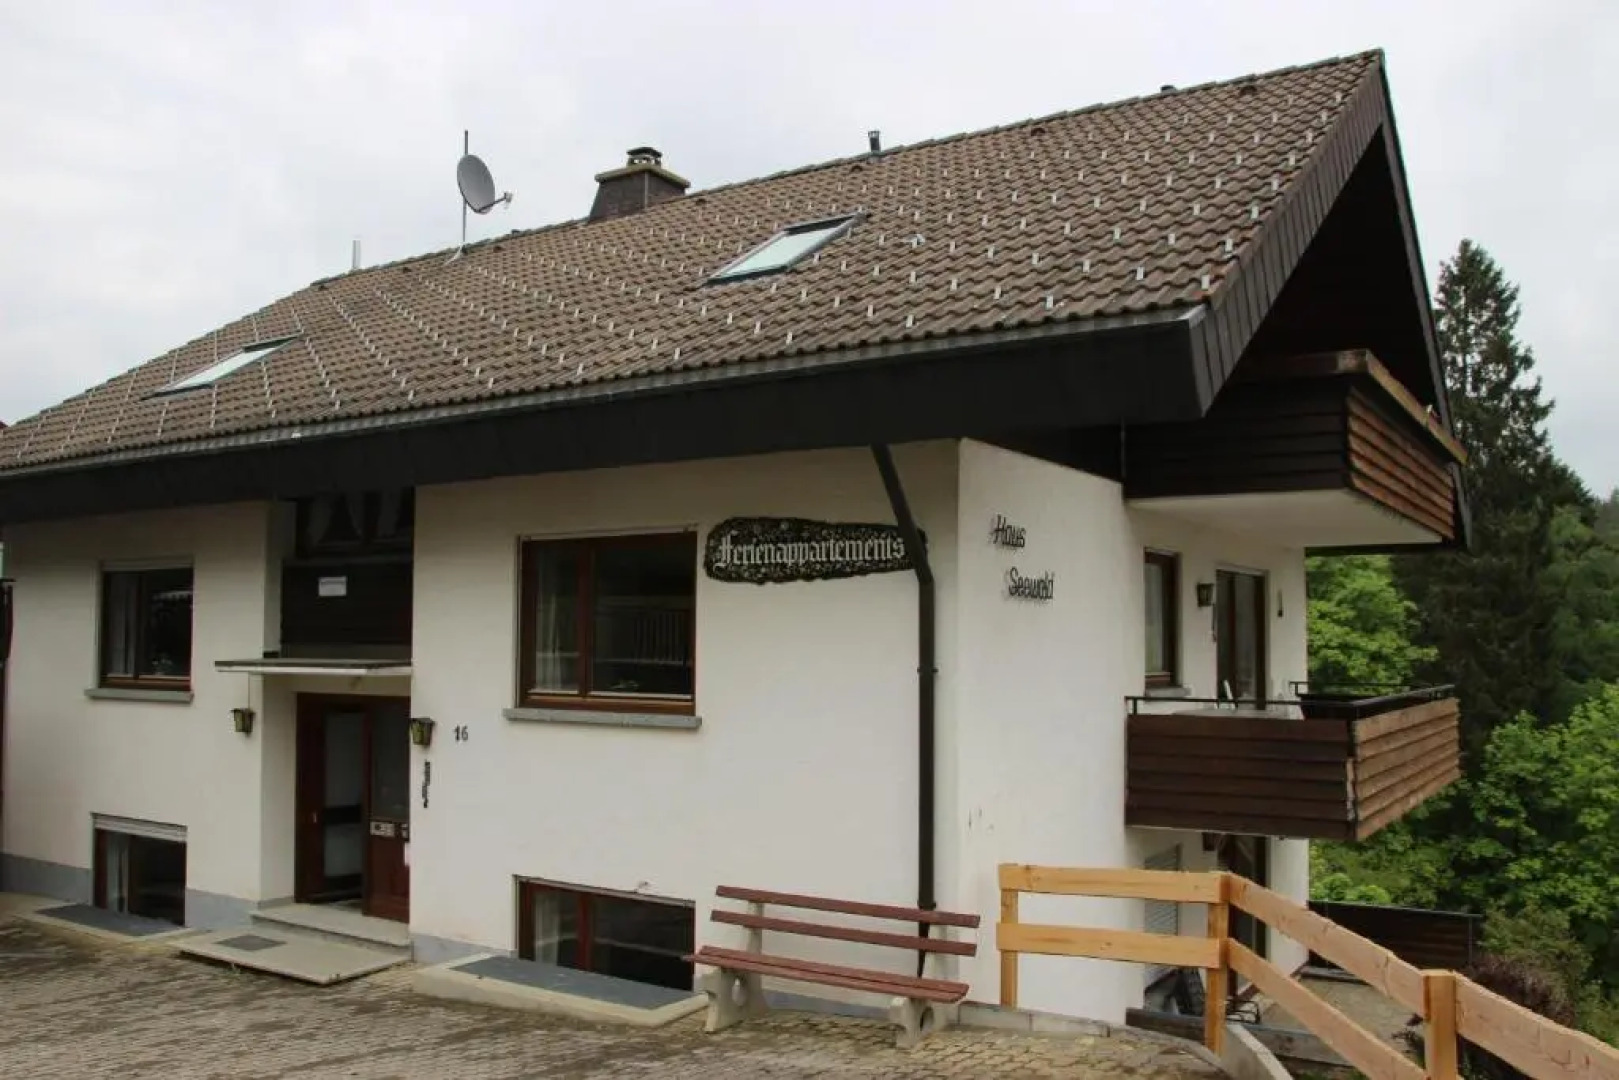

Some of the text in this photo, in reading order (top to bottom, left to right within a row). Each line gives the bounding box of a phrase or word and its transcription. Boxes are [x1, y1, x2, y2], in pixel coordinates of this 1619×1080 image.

[992, 513, 1026, 548] Haus
[712, 530, 905, 569] Ferienappartements
[454, 724, 469, 741] 16
